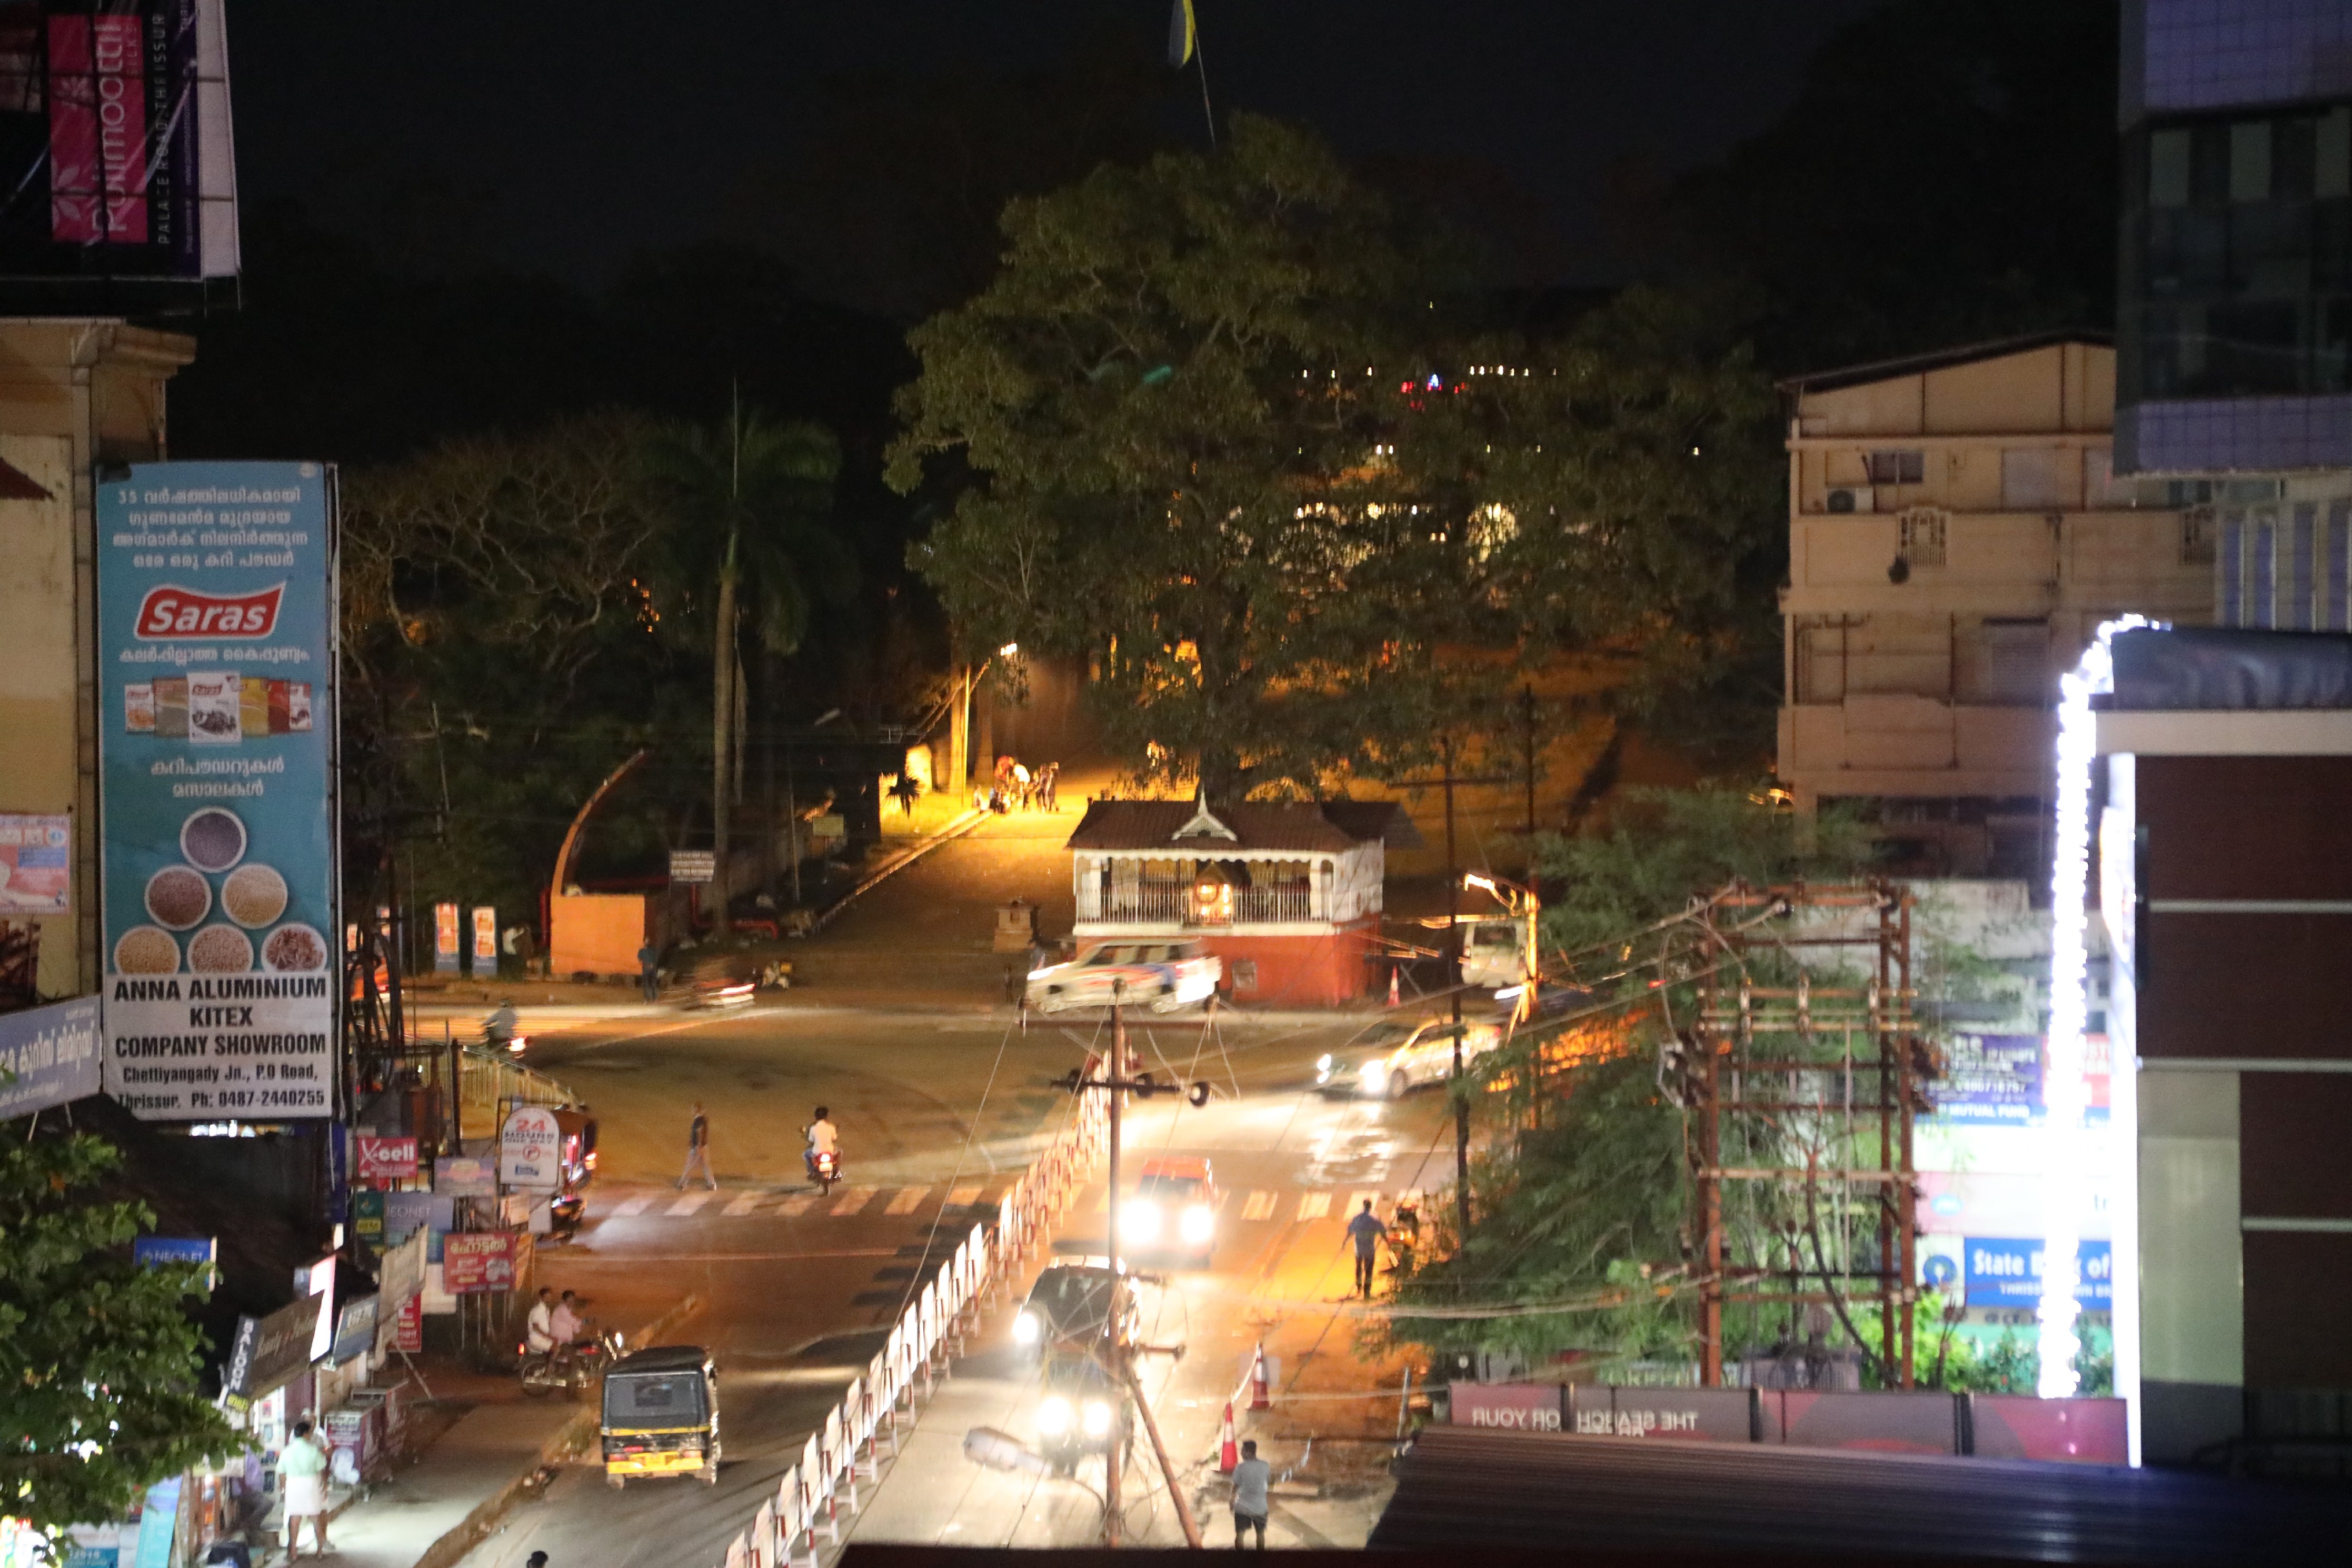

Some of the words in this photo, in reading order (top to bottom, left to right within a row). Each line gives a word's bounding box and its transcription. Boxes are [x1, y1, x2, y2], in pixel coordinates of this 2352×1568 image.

[118, 490, 137, 504] 35
[147, 599, 267, 633] Saras
[114, 980, 181, 1002] ANNA
[188, 977, 326, 1001] ALUMINIUM
[190, 1006, 254, 1029] KITEX
[115, 1034, 208, 1058] COMPANY
[215, 1033, 326, 1056] SHOWROOM
[281, 1063, 318, 1083] Road,
[191, 1091, 213, 1108] Ph:
[218, 1089, 325, 1108] 0487-2440255
[1949, 1103, 1997, 1118] MUTUAL
[1998, 1103, 2030, 1118] FUND
[516, 1118, 546, 1132] 24
[1973, 1248, 2025, 1276] State
[2087, 1253, 2111, 1279] of
[230, 1317, 254, 1391] SALOON
